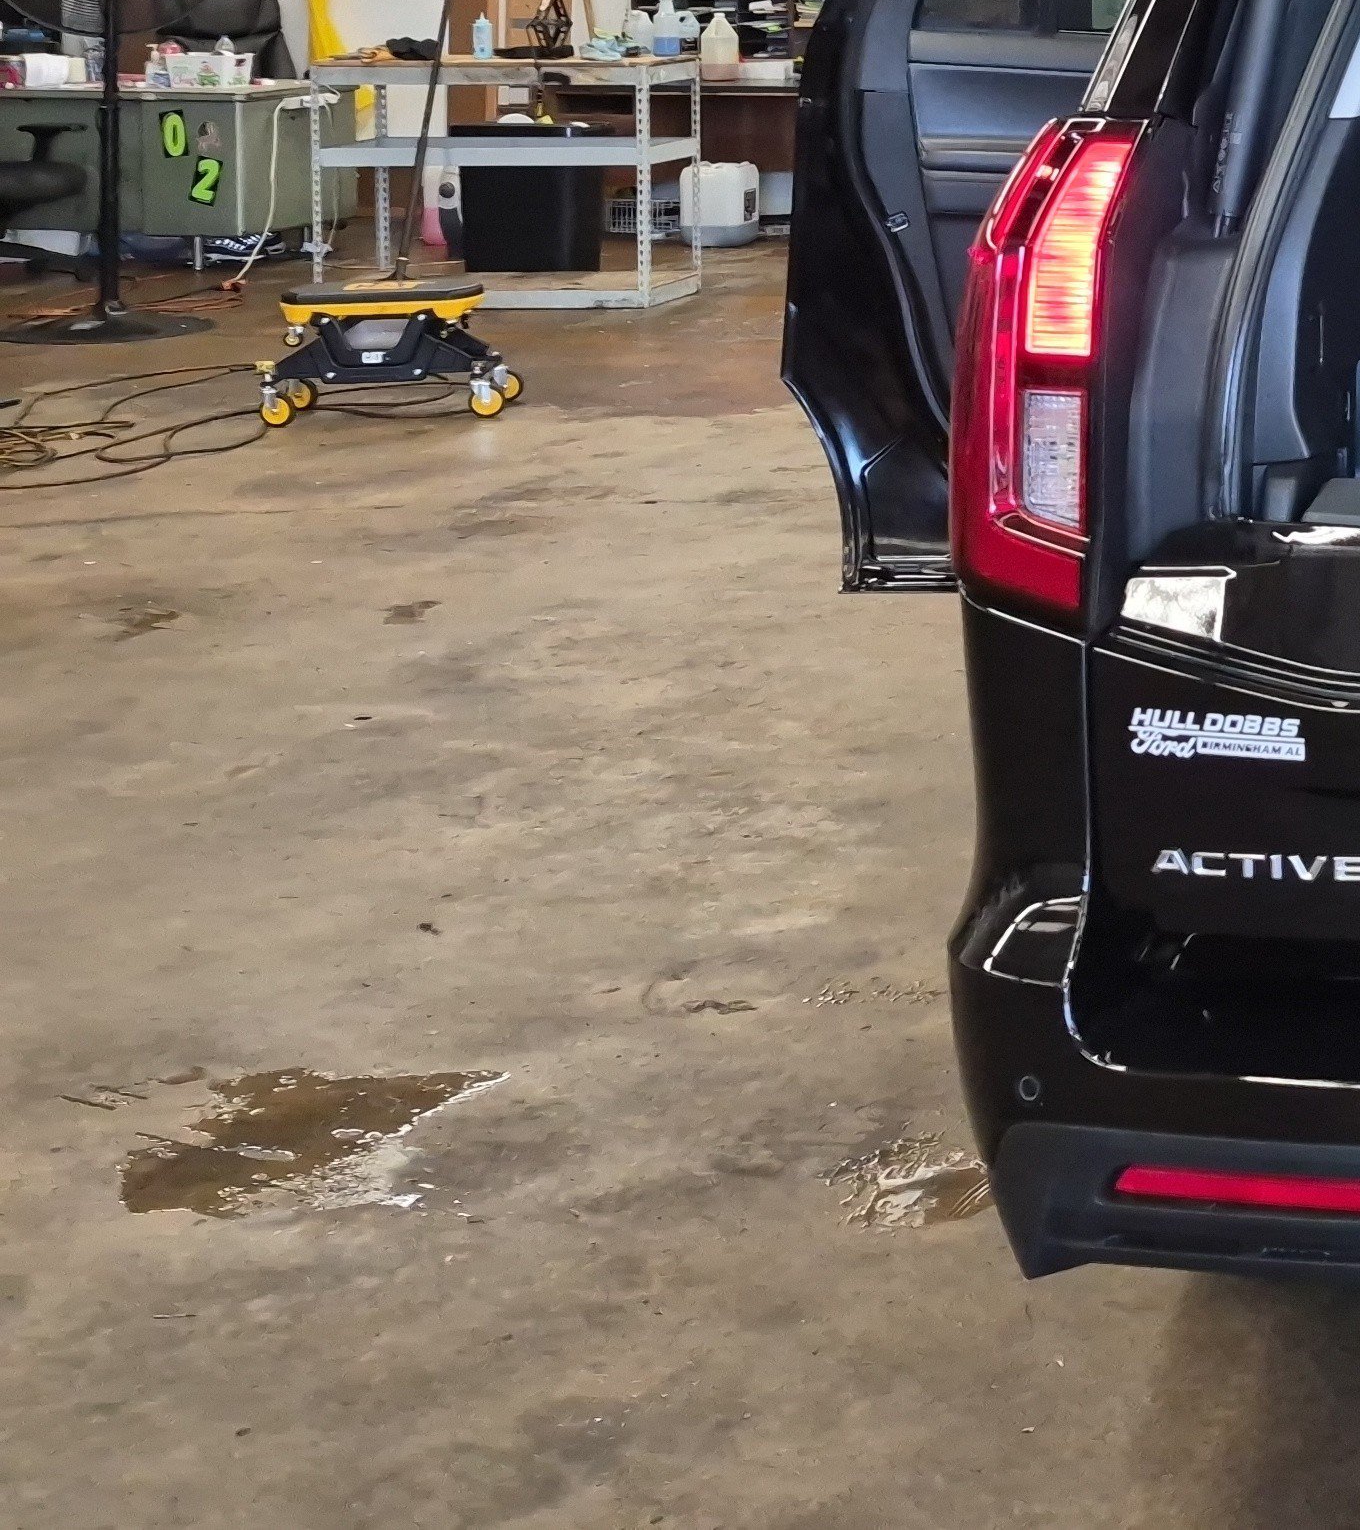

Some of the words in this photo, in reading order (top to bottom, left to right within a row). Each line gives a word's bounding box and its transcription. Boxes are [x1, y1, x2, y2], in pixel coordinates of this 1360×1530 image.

[191, 159, 220, 203] 2
[1131, 707, 1200, 730] HULL
[1203, 713, 1300, 737] DOBBS
[1130, 728, 1197, 758] Ford
[1200, 740, 1282, 756] BIRMINGHAM
[1285, 746, 1302, 756] AL
